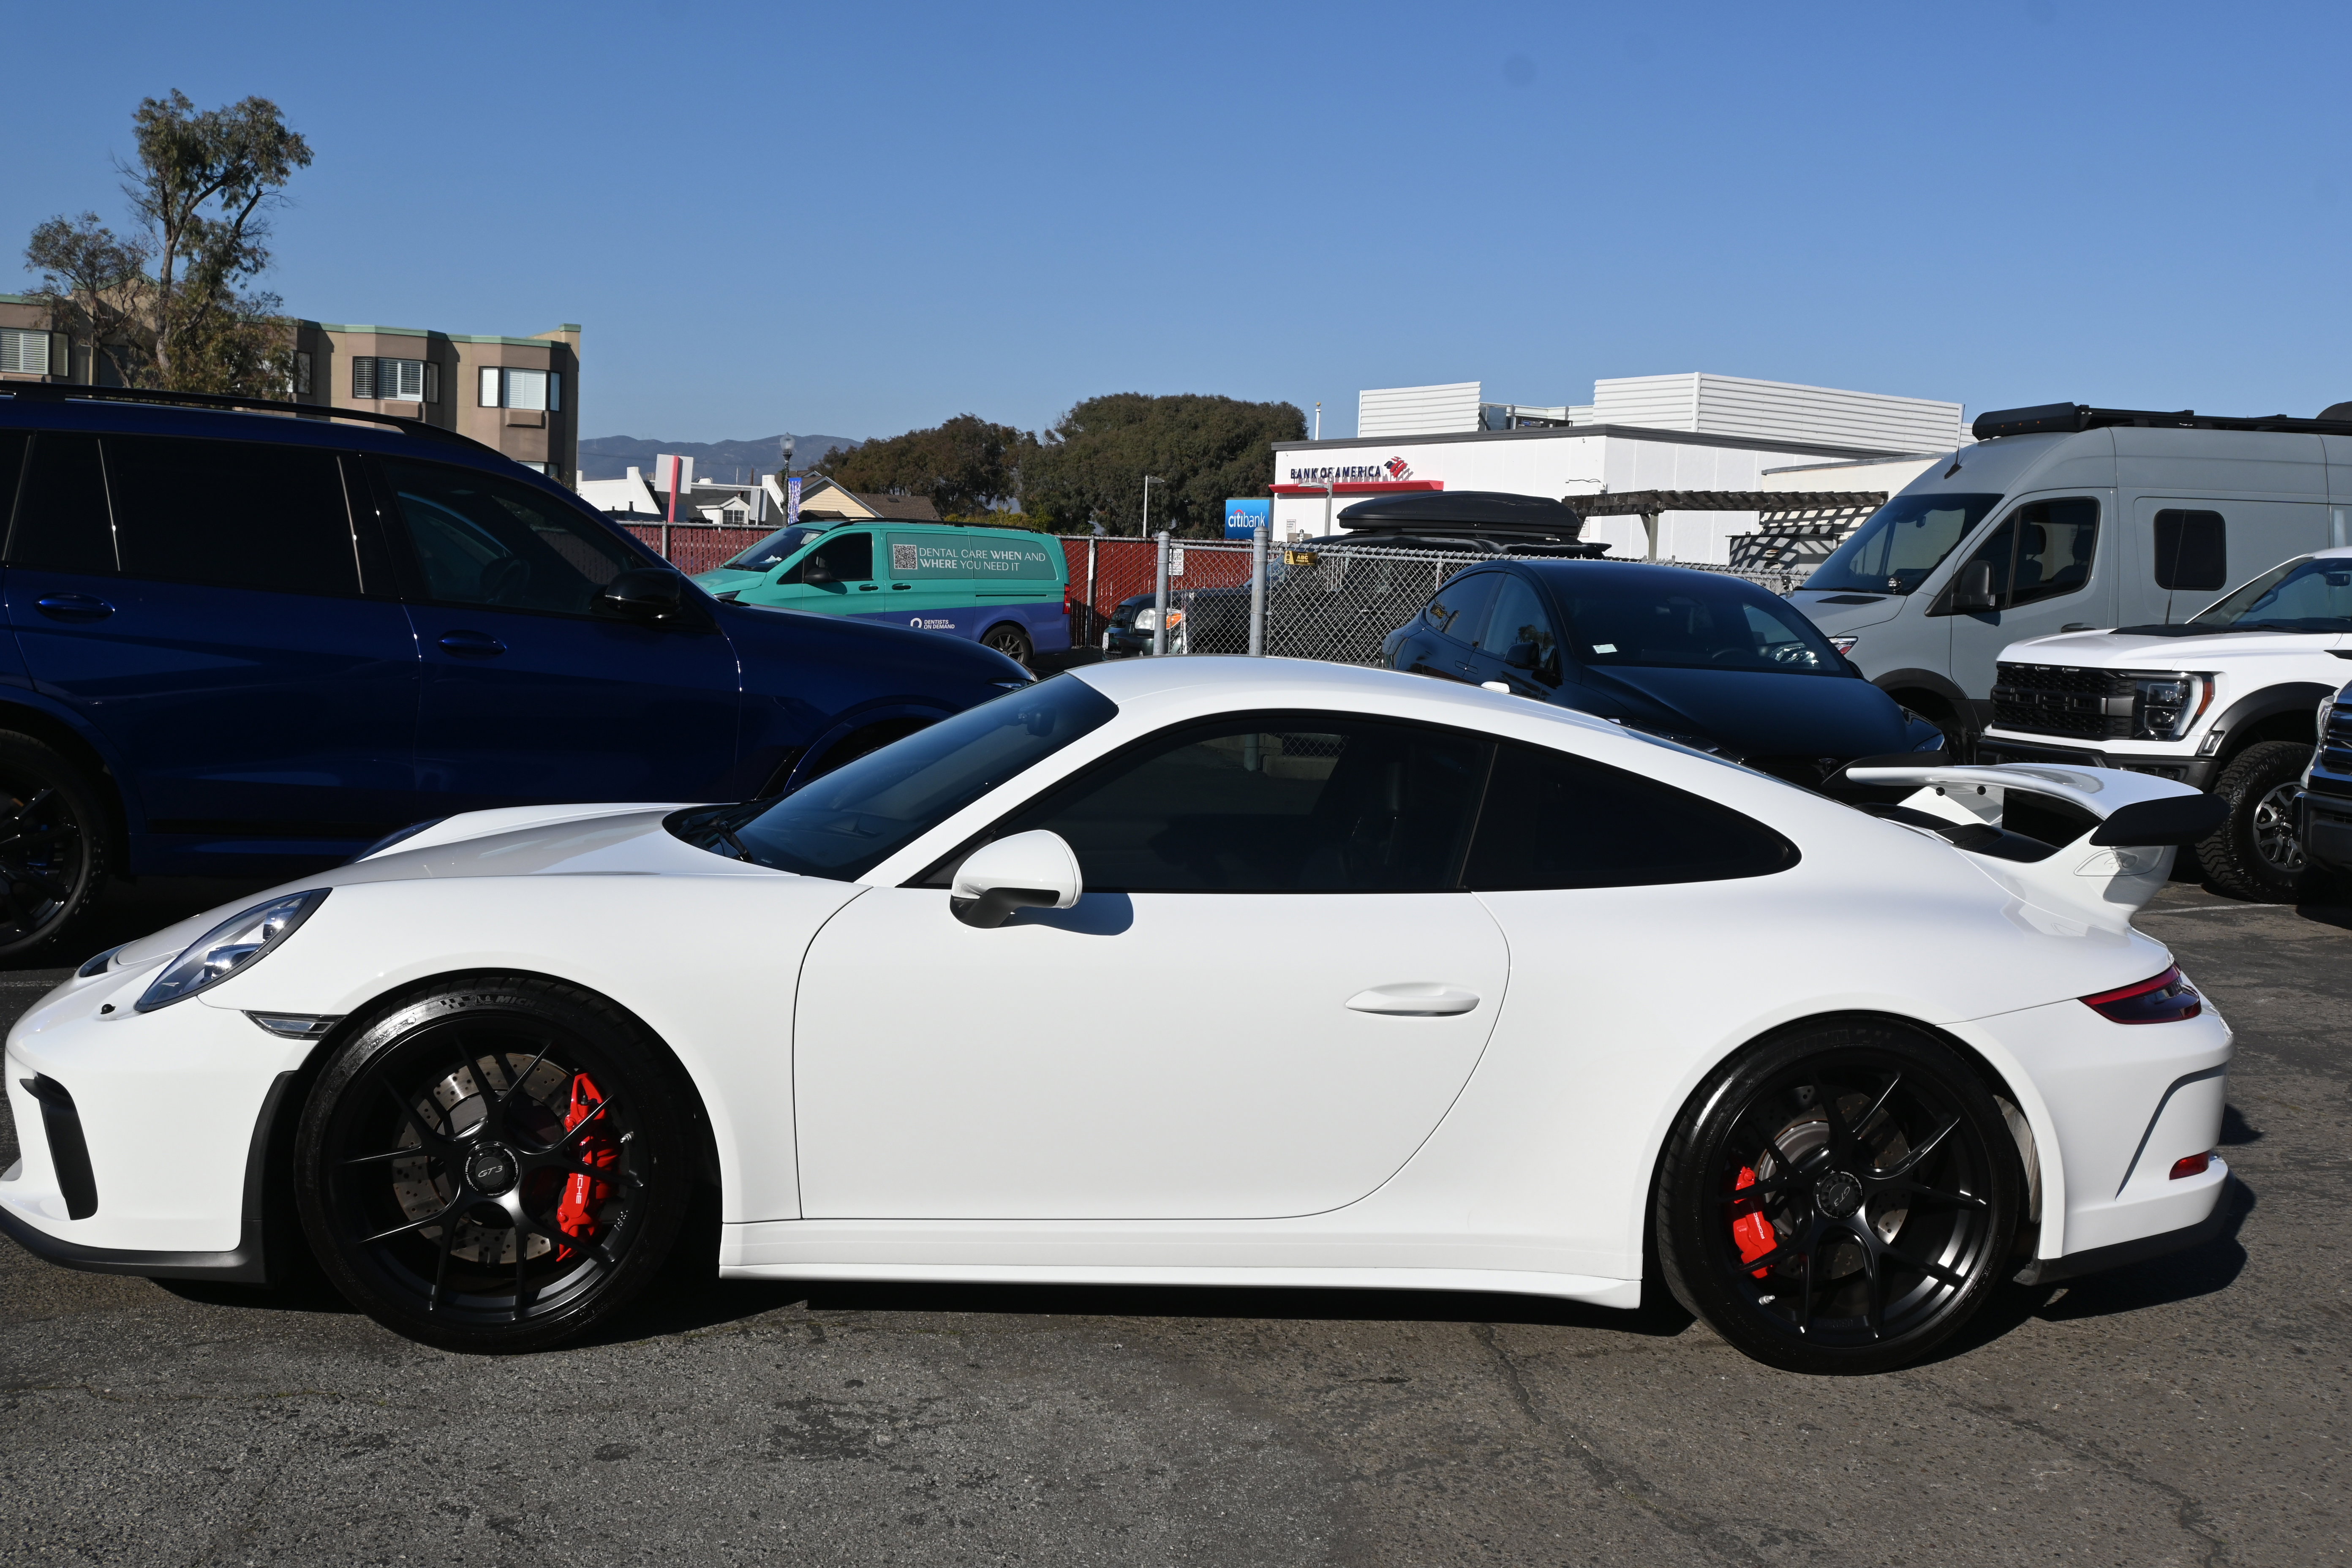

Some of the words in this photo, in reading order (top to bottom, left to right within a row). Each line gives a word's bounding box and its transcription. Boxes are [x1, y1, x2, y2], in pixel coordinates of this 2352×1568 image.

[1290, 468, 1318, 479] BANK
[1320, 467, 1334, 478] OF
[1335, 465, 1383, 477] AMERICA
[1228, 512, 1265, 527] citibank
[919, 547, 958, 558] DENTAL
[961, 549, 988, 559] CARE
[990, 550, 1022, 560] WHEN
[1024, 553, 1045, 561] AND
[920, 558, 957, 569] WHERE
[960, 560, 981, 569] YOU
[984, 562, 1009, 571] NEED
[1012, 563, 1020, 571] IT
[478, 1165, 503, 1177] GT3
